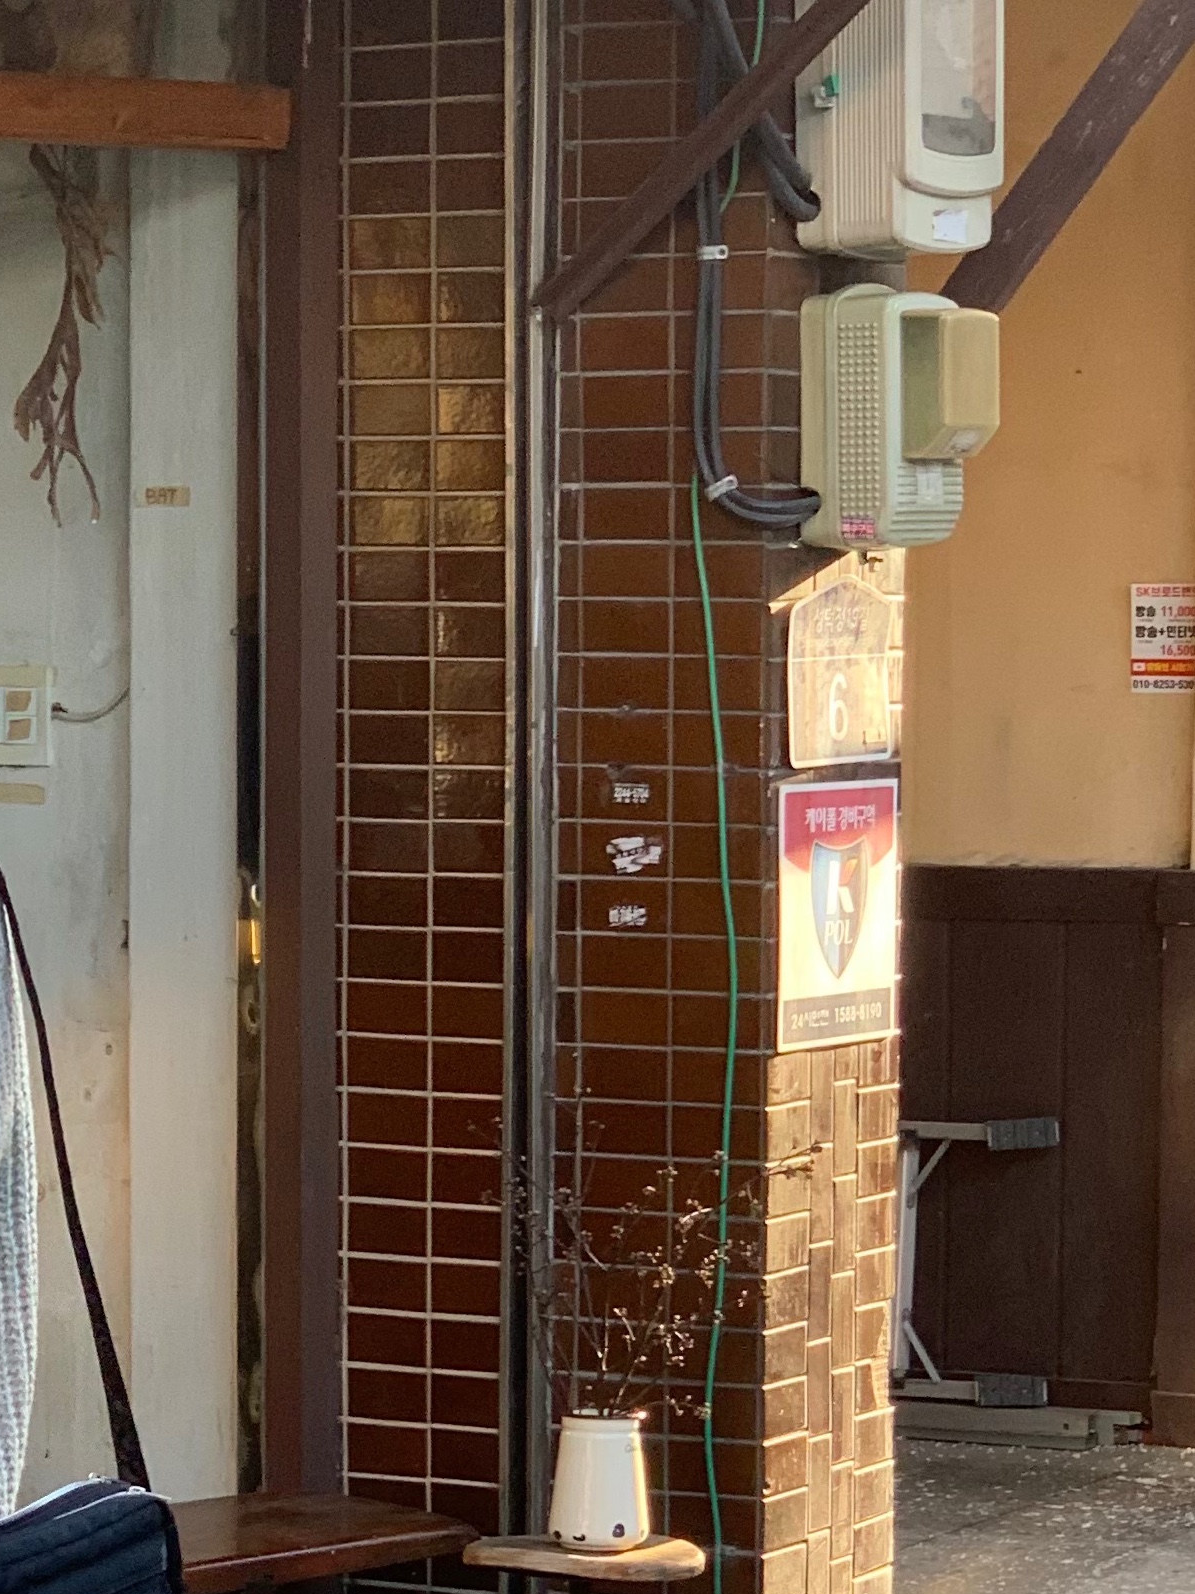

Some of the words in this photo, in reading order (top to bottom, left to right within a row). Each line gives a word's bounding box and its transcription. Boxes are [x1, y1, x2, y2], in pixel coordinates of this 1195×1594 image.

[828, 672, 849, 742] 6
[825, 858, 859, 916] K
[823, 918, 854, 947] POL
